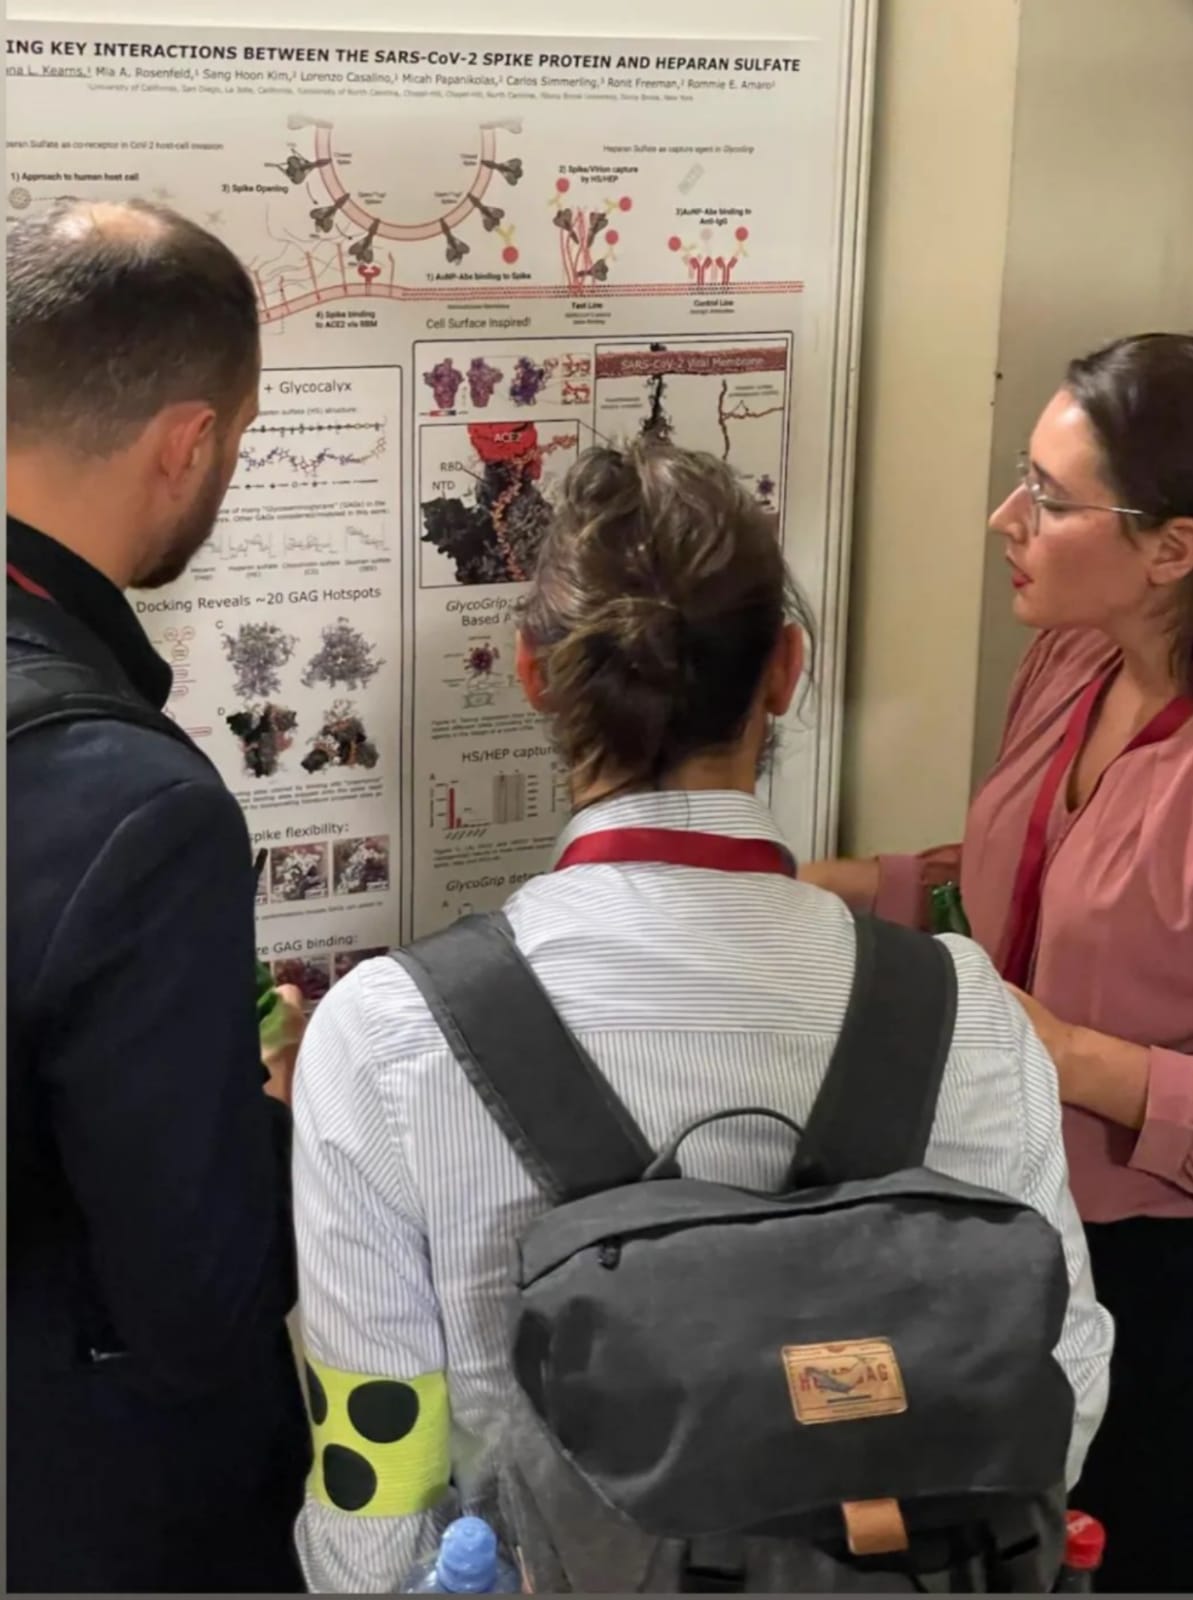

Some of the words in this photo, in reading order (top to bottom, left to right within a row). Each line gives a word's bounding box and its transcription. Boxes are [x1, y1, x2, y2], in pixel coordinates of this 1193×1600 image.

[6, 40, 44, 54] ING
[50, 41, 87, 56] KEY
[94, 43, 237, 60] INTERACTIONS
[243, 47, 329, 62] BETWEEN
[336, 49, 369, 63] THE
[374, 50, 478, 66] SARS-CoV-2
[483, 52, 533, 67] SPIKE
[538, 54, 612, 69] PROTEIN
[616, 56, 650, 70] AND
[656, 57, 729, 71] HEPARAN
[734, 58, 800, 72] SULFATE
[96, 67, 115, 77] Mia
[119, 67, 131, 77] A.
[203, 69, 231, 81] Sang
[235, 70, 263, 80] Hoon
[300, 72, 343, 82] Lorenzo
[402, 74, 432, 84] Micah
[506, 75, 537, 86] Carlos
[607, 77, 632, 88] Ronit
[688, 79, 726, 90] Rommie
[729, 79, 738, 90] E.
[426, 318, 445, 329] Cell
[448, 317, 486, 328] Surface
[489, 316, 531, 330] Inspired!
[279, 379, 353, 394] Glycocalyx
[432, 480, 456, 491] NTD
[136, 598, 193, 614] Docking
[198, 595, 251, 610] Reveals
[255, 591, 284, 606] ~20
[288, 590, 319, 603] GAG
[323, 586, 382, 602] Hotspots
[461, 614, 500, 627] Based
[462, 748, 509, 763] HS/HEP
[286, 822, 350, 838] flexibility:
[446, 875, 505, 892] GlycoGrip
[273, 940, 303, 954] GAG
[306, 933, 359, 950] binding:
